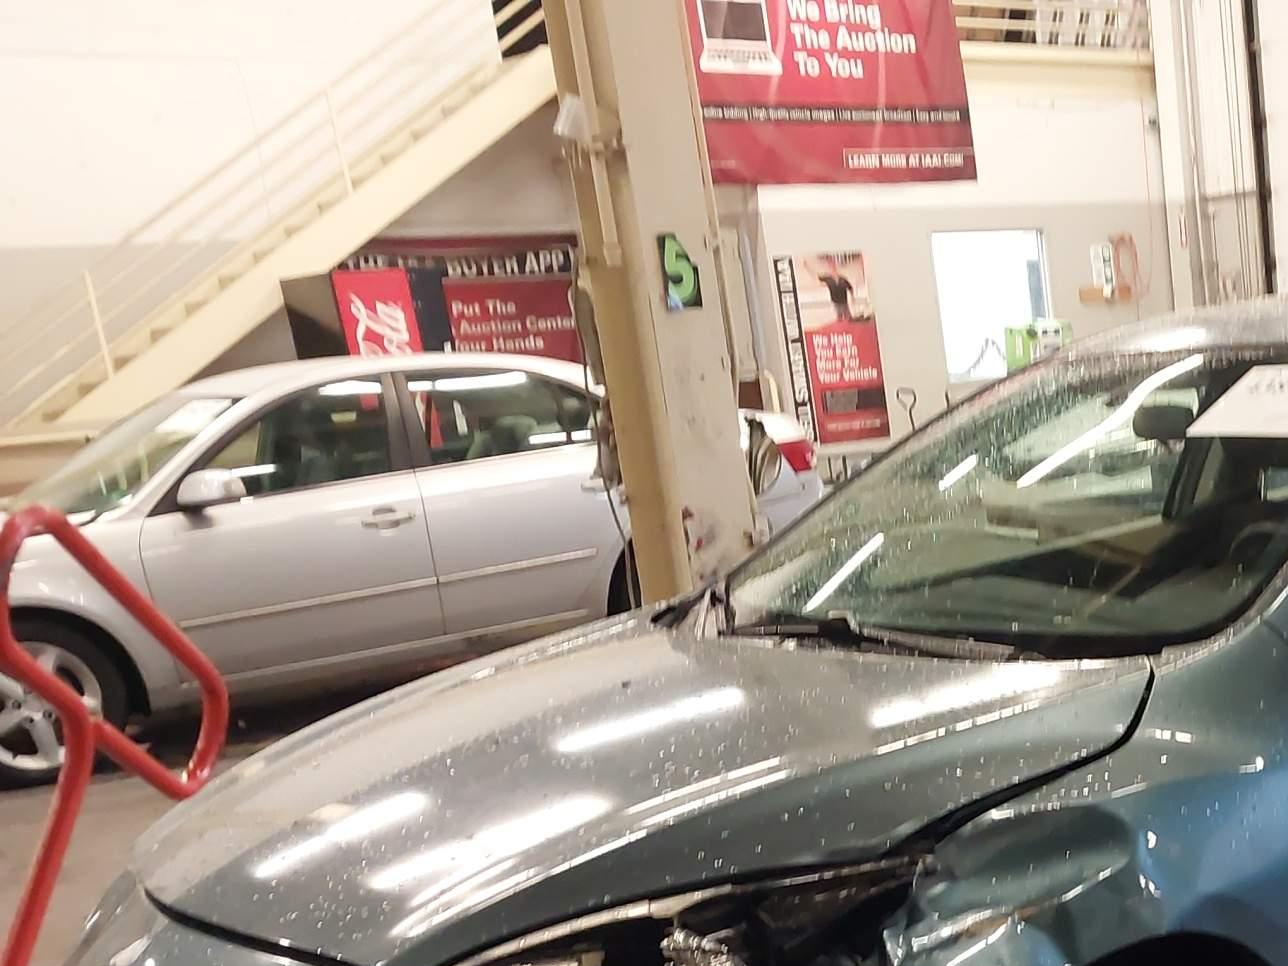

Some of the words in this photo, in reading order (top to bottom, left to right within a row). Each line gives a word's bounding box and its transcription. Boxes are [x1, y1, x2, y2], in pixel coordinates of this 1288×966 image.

[787, 0, 819, 21] We
[824, 0, 881, 30] Bring
[790, 22, 830, 50] The
[837, 24, 917, 54] Auction
[793, 51, 820, 77] To
[824, 51, 864, 79] You
[848, 153, 880, 168] LEARN
[881, 153, 907, 168] MORE
[908, 153, 920, 168] AT
[921, 152, 963, 168] IAAI.COM
[524, 249, 564, 275] APP
[664, 234, 696, 307] 5
[451, 300, 481, 318] Put
[486, 299, 516, 316] The
[460, 319, 522, 336] Auction
[492, 334, 544, 352] Hands
[830, 332, 853, 349] Help
[843, 365, 878, 382] Vehicle
